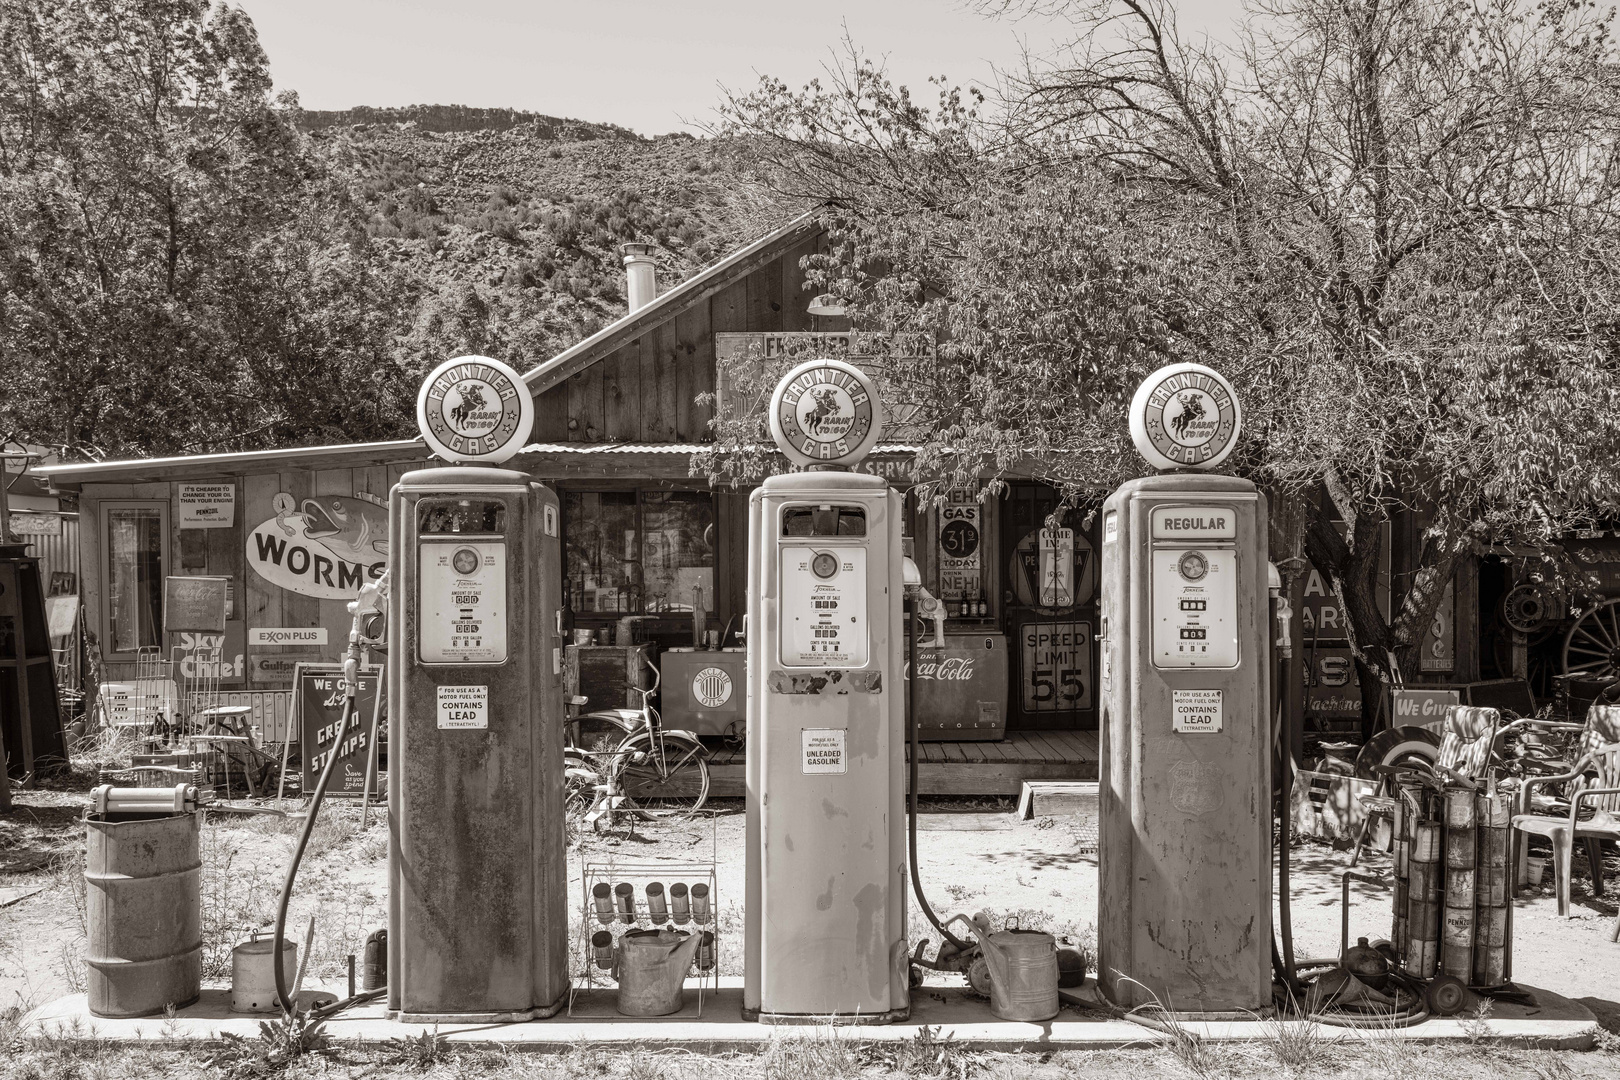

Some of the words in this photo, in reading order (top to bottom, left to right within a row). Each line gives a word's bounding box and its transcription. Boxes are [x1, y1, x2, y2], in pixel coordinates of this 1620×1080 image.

[429, 364, 517, 401] FRONTIER
[782, 369, 869, 406] FRONTIER
[1148, 373, 1232, 410] FRONTIER
[449, 432, 500, 455] GAS
[801, 438, 850, 459] GAS
[1165, 442, 1212, 463] GAS
[943, 508, 975, 520] GAS
[1164, 518, 1226, 530] REGULAR
[255, 532, 386, 592] WORMS
[942, 577, 979, 590] NEHI
[180, 632, 225, 655] Sky
[260, 632, 290, 643] EXXON
[1027, 633, 1085, 647] SPEED
[180, 654, 244, 678] Chief
[1034, 651, 1078, 666] LIMIT
[695, 668, 730, 684] SINCLAIR
[314, 679, 332, 690] WE
[1031, 669, 1084, 701] 55
[702, 697, 724, 707] OILS
[1397, 699, 1419, 716] WE
[1422, 699, 1448, 716] GIV
[449, 712, 476, 720] LEAD
[345, 764, 362, 776] Save
